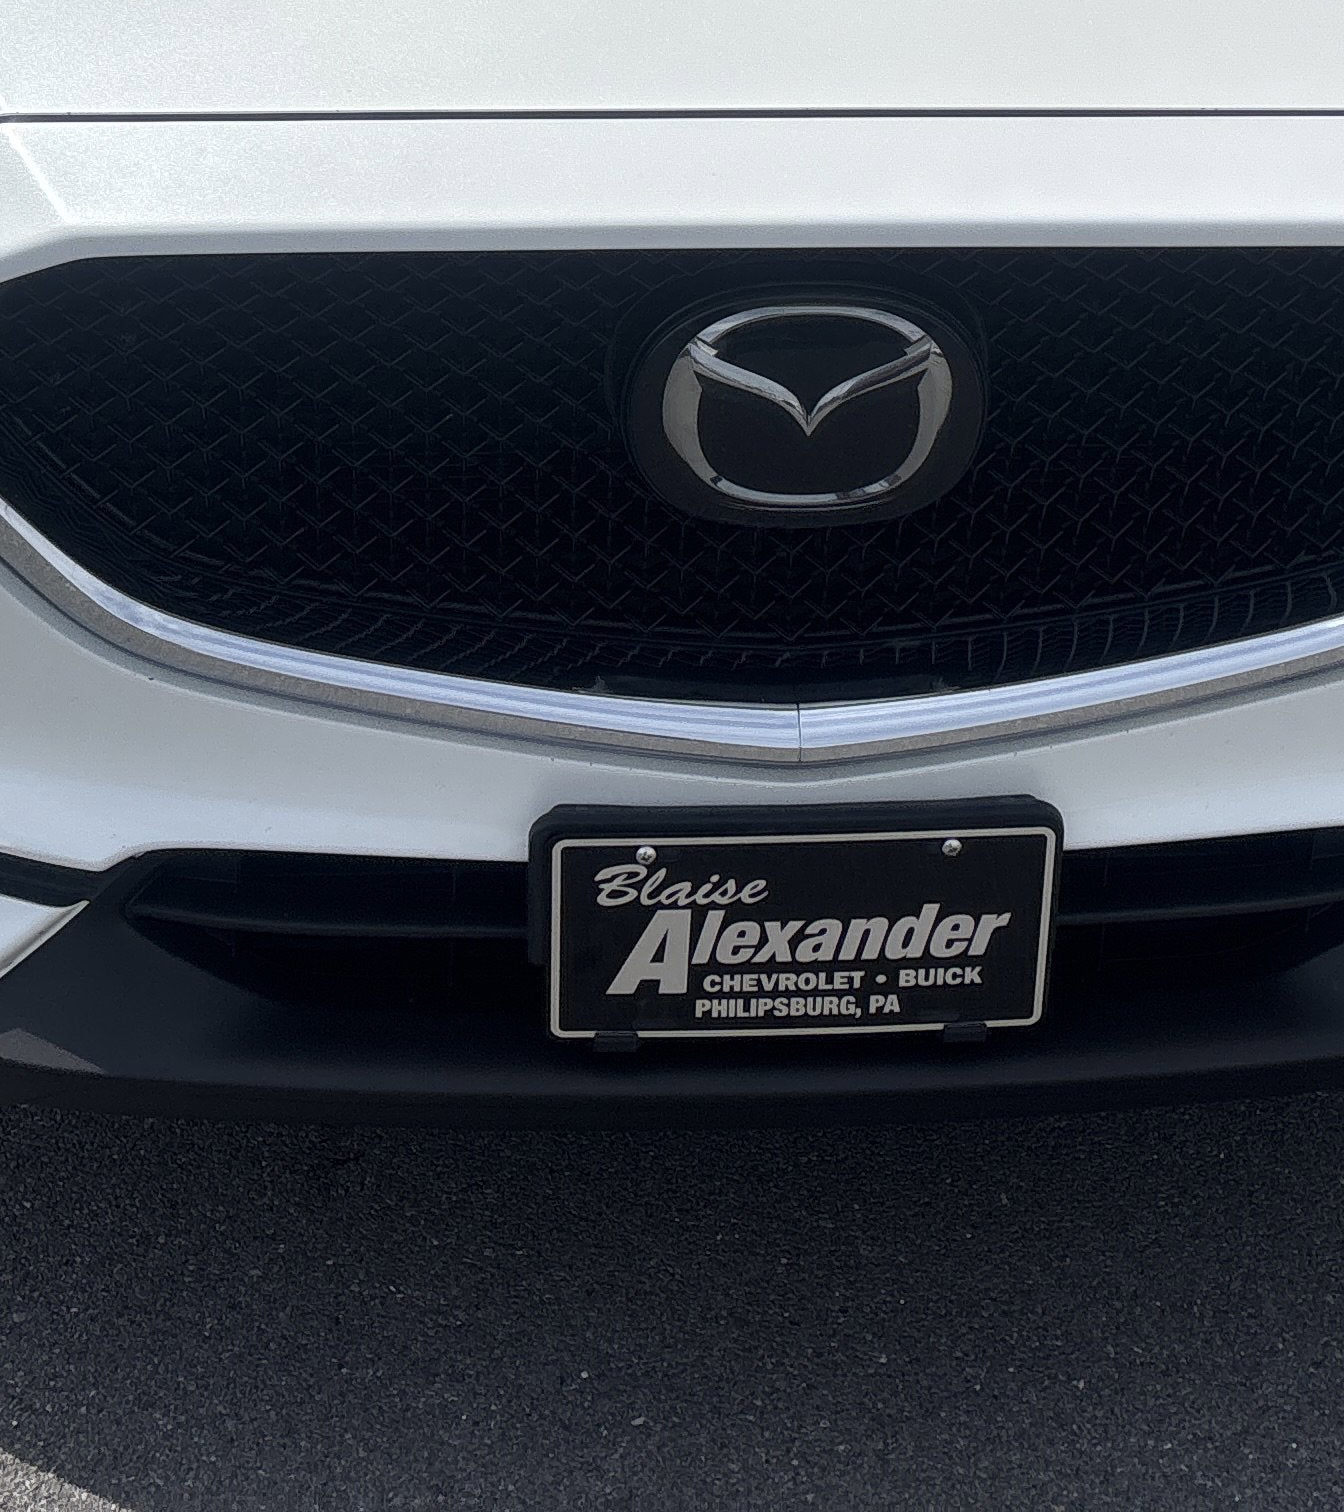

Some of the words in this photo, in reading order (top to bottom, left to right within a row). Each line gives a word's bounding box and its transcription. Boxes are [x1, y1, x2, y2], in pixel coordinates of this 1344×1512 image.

[594, 863, 769, 907] Blaise
[606, 902, 1012, 995] Alexander
[703, 971, 865, 992] CHEVROLET
[898, 966, 983, 987] BUICK
[695, 995, 862, 1018] PHILIPSBURG,
[868, 994, 901, 1014] PA
